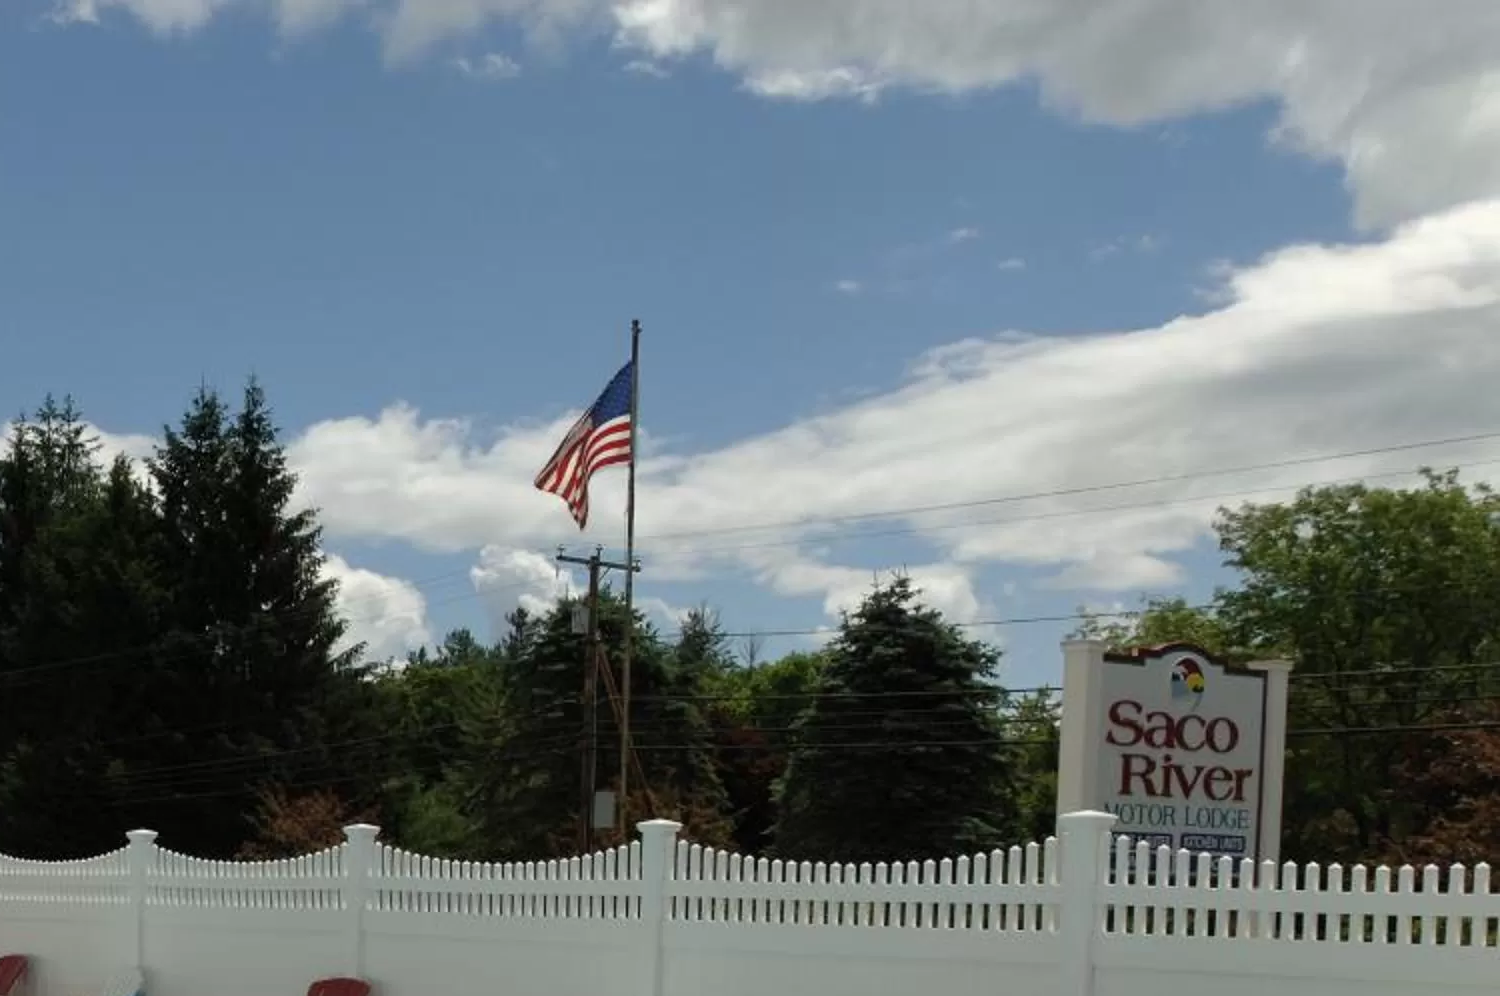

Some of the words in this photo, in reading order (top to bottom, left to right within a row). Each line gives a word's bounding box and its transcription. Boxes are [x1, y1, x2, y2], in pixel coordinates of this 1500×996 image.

[1106, 700, 1239, 752] Saco
[1118, 754, 1253, 801] River
[1185, 806, 1250, 829] LODGE
